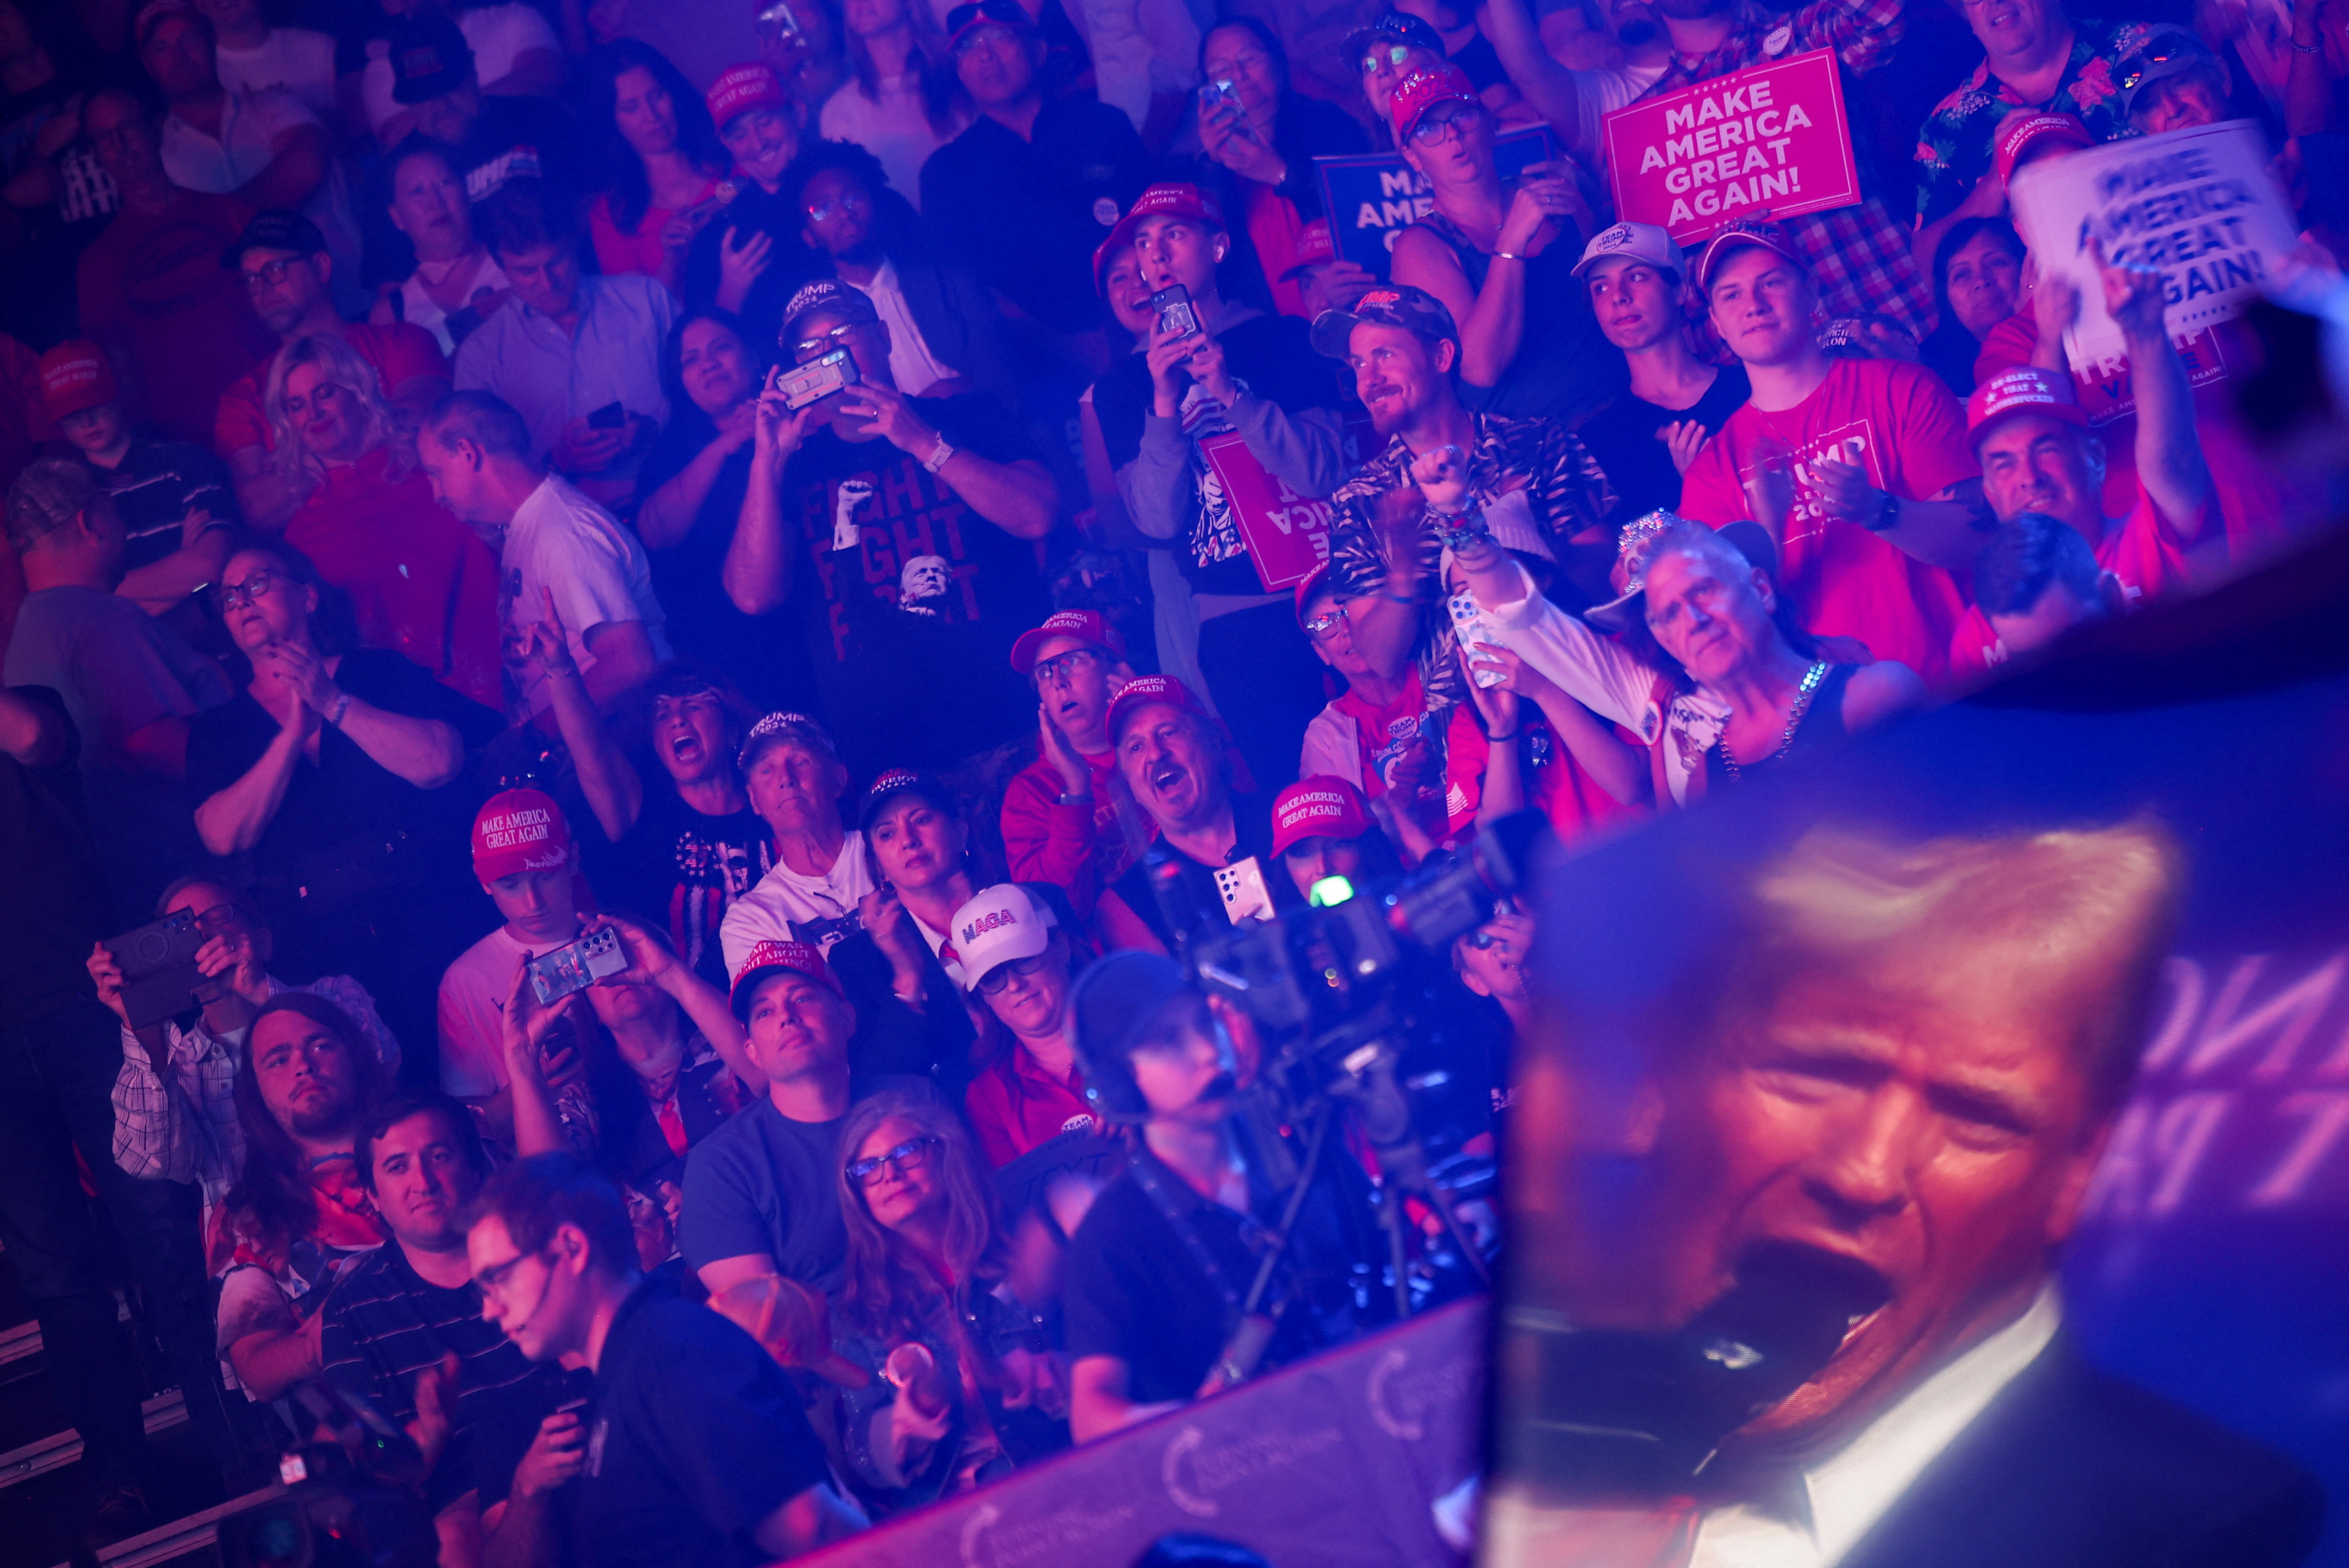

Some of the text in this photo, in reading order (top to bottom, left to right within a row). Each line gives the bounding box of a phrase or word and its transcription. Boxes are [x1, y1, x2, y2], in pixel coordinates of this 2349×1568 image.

[726, 67, 769, 85] AMERICA
[1665, 80, 1774, 135] MAKE
[1640, 103, 1813, 175] AMERICA
[1665, 136, 1791, 194] GREAT
[1379, 170, 1434, 198] MA
[1151, 197, 1177, 206] AGAIN
[1667, 166, 1801, 228] AGAIN!
[1599, 234, 1625, 248] TRUMP
[1602, 231, 1623, 242] TEAM
[2160, 249, 2266, 304] GAIN!
[786, 283, 835, 314] TRUMP
[1051, 620, 1081, 629] AGAIN
[1124, 678, 1167, 693] AMERICA
[749, 712, 806, 738] TRUMP
[1388, 717, 1412, 731] TEAM
[1388, 720, 1416, 735] TRUMP
[871, 775, 918, 794] PATRIOT
[1278, 792, 1345, 818] MAKE AMERICA
[1282, 804, 1342, 828] GREAT AGAIN
[482, 808, 551, 836] MAKE AMERICA
[486, 824, 549, 849] GREAT AGAIN
[962, 909, 1016, 945] MAGA
[765, 950, 811, 961] ABOUT
[1064, 1116, 1089, 1129] TEAM
